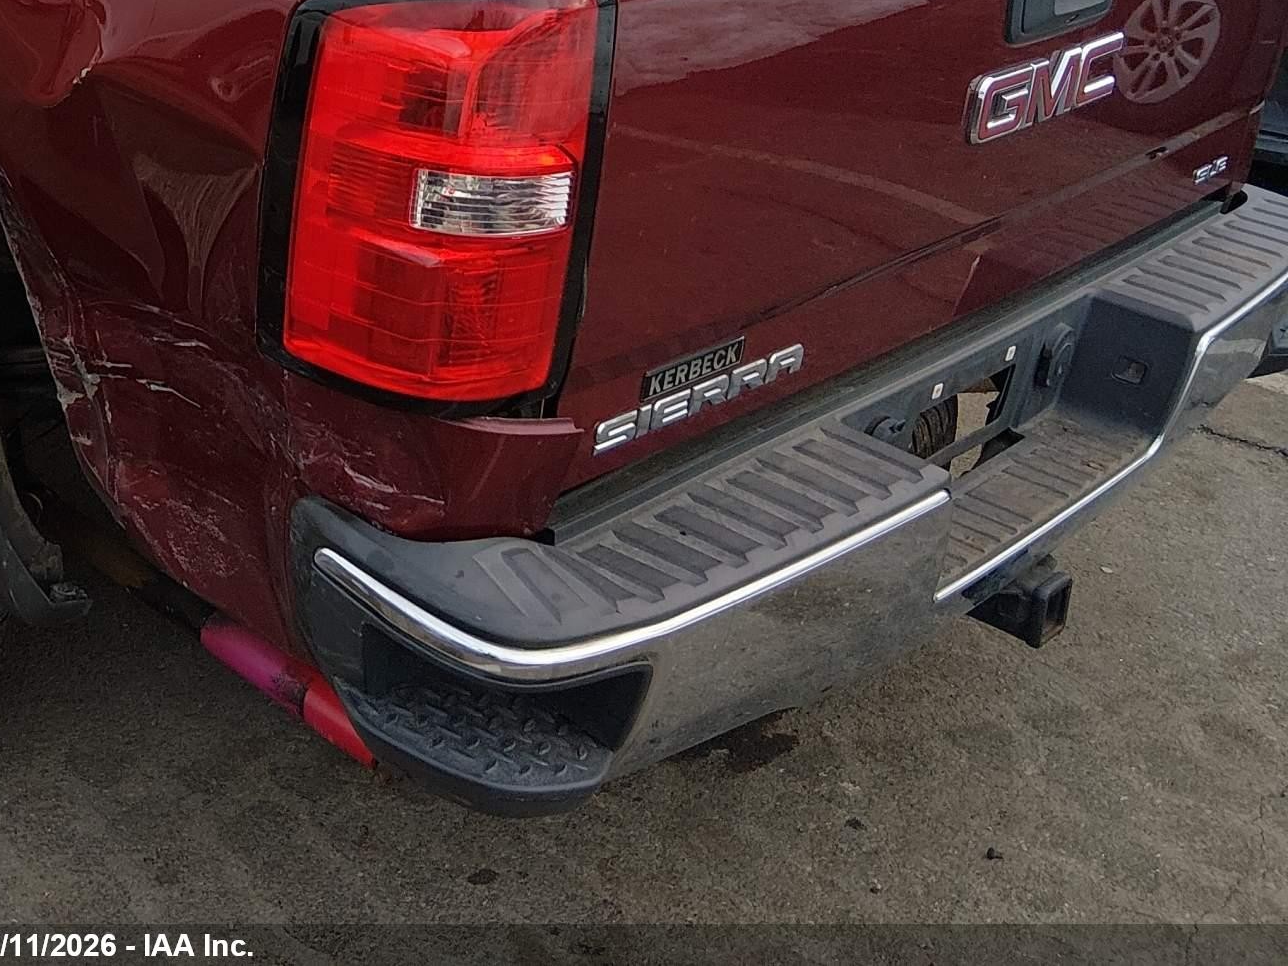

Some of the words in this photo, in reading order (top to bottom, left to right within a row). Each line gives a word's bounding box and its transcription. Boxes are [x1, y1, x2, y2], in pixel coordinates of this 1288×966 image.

[968, 31, 1125, 144] GMC
[592, 342, 805, 457] SIERRA
[647, 342, 739, 397] KERBECK
